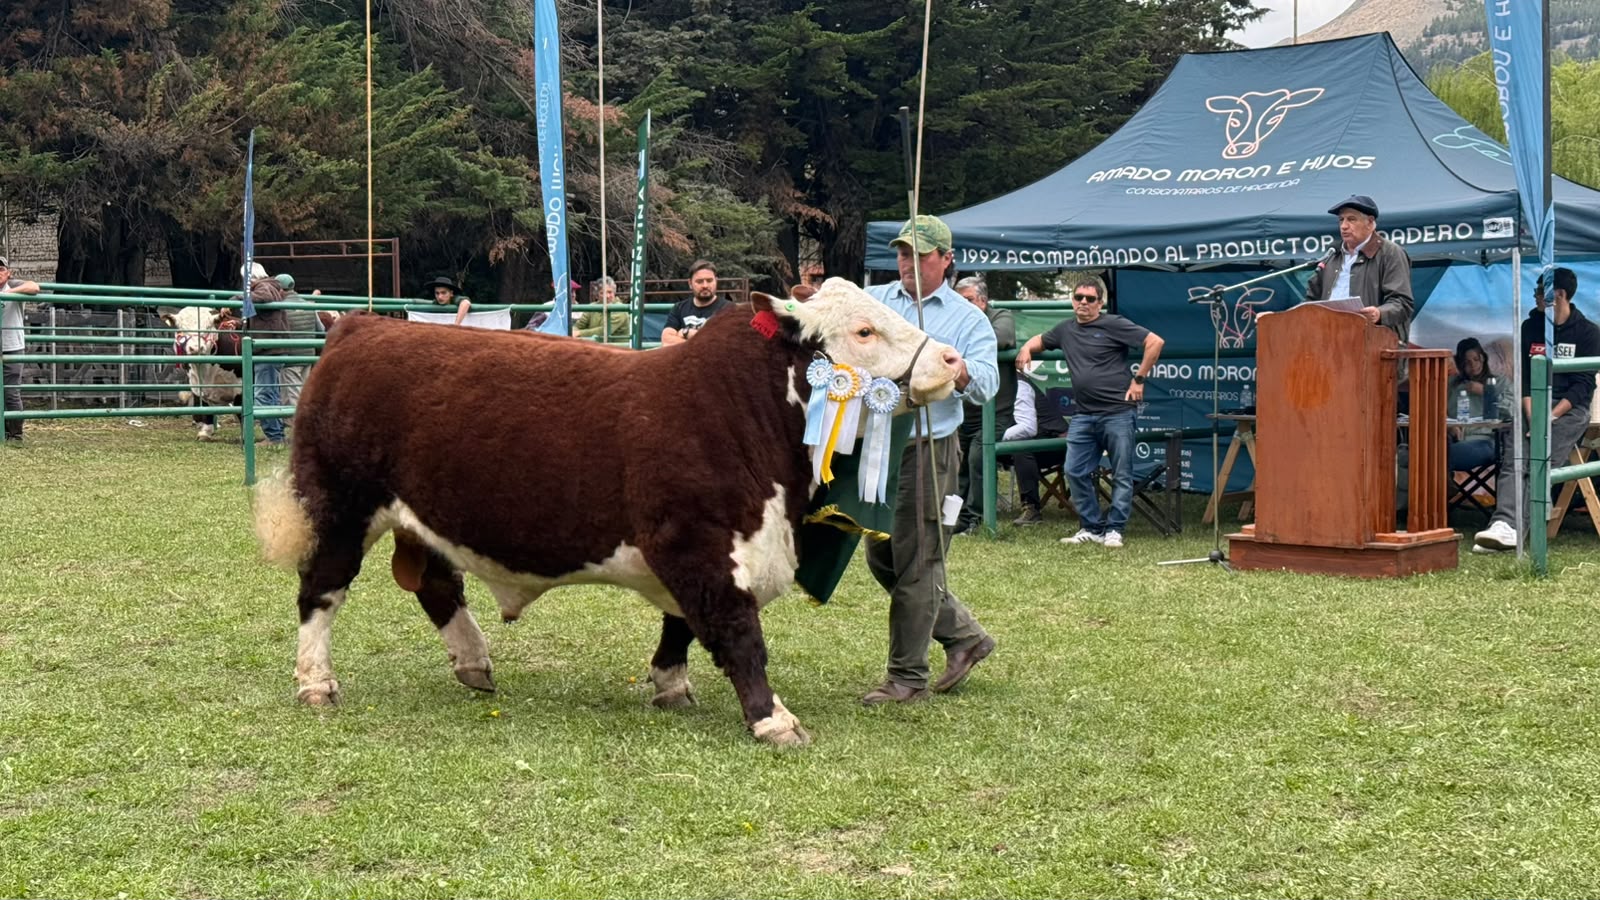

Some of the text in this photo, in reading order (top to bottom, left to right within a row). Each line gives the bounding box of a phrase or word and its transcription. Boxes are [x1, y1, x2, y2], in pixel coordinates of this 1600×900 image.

[1086, 154, 1376, 184] AMADO MORON E HIJOS
[1125, 178, 1300, 196] CONSIGNATARIOS DE HACIENDA
[962, 248, 1000, 264] 1992
[1005, 245, 1158, 266] ACOMPAÑANDO
[1165, 245, 1189, 263] AL
[1196, 234, 1334, 260] PRODUCTOR
[1376, 222, 1473, 246] ADERO
